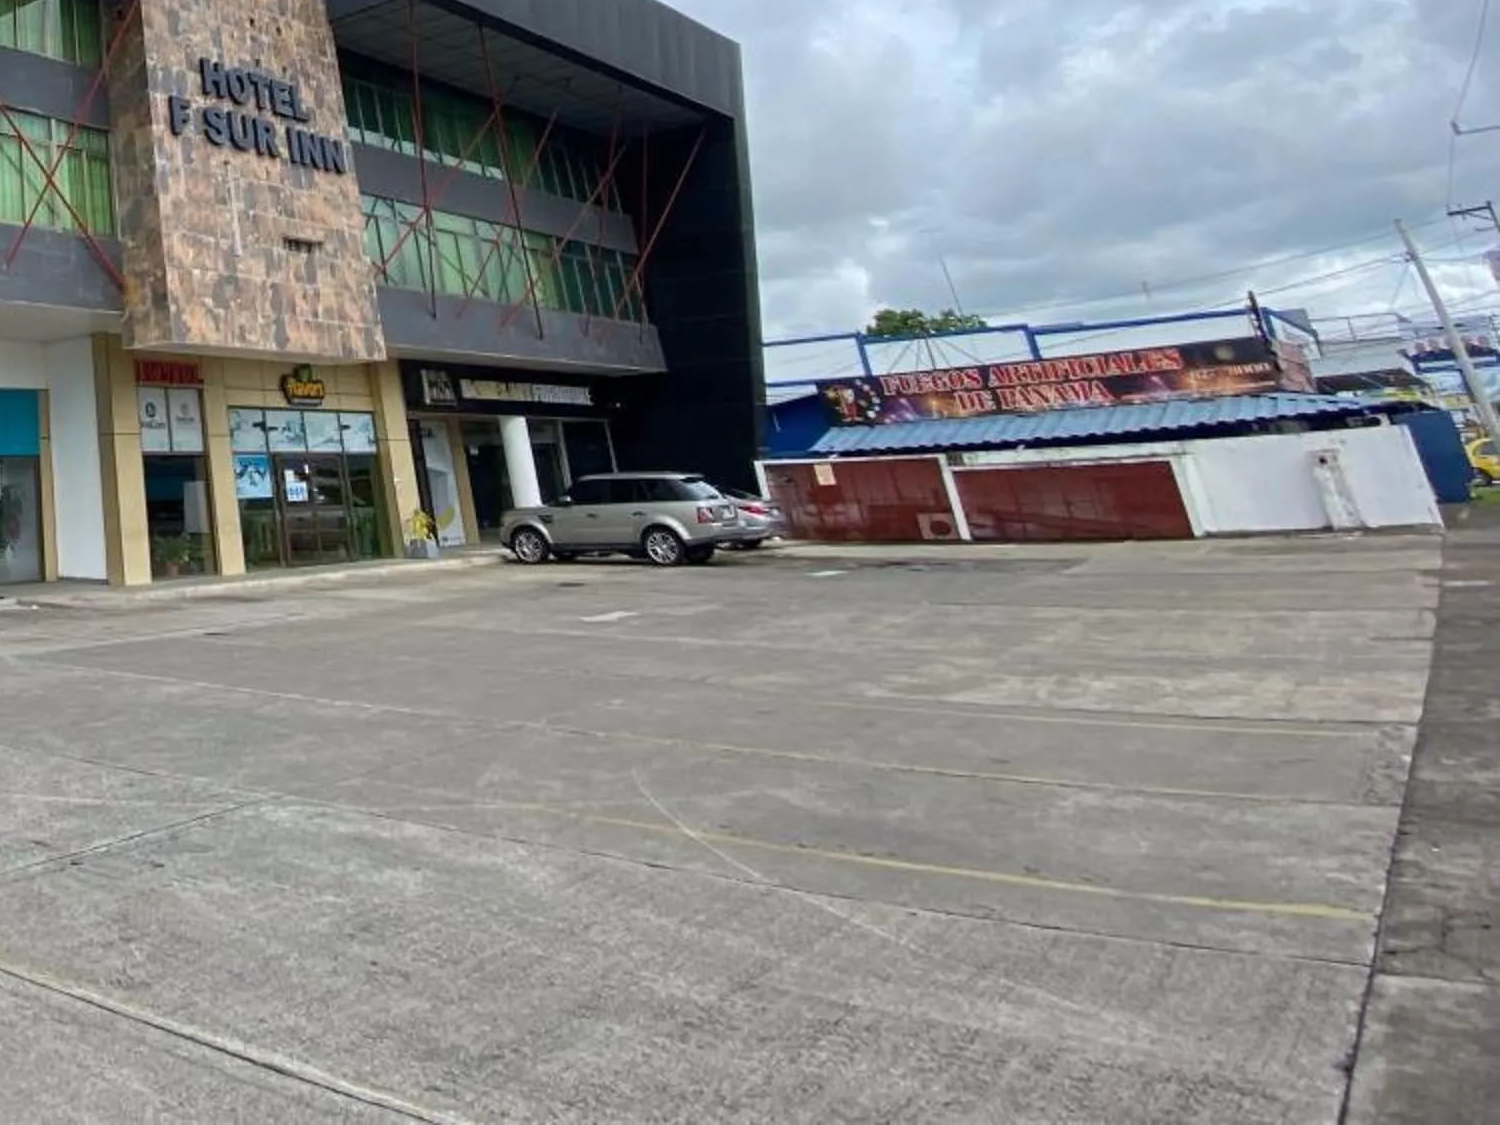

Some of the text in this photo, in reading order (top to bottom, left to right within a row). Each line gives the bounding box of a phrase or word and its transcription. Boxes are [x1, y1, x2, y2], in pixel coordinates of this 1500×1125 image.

[199, 58, 309, 123] HOTEL
[203, 106, 279, 158] SUR
[286, 125, 347, 174] INN
